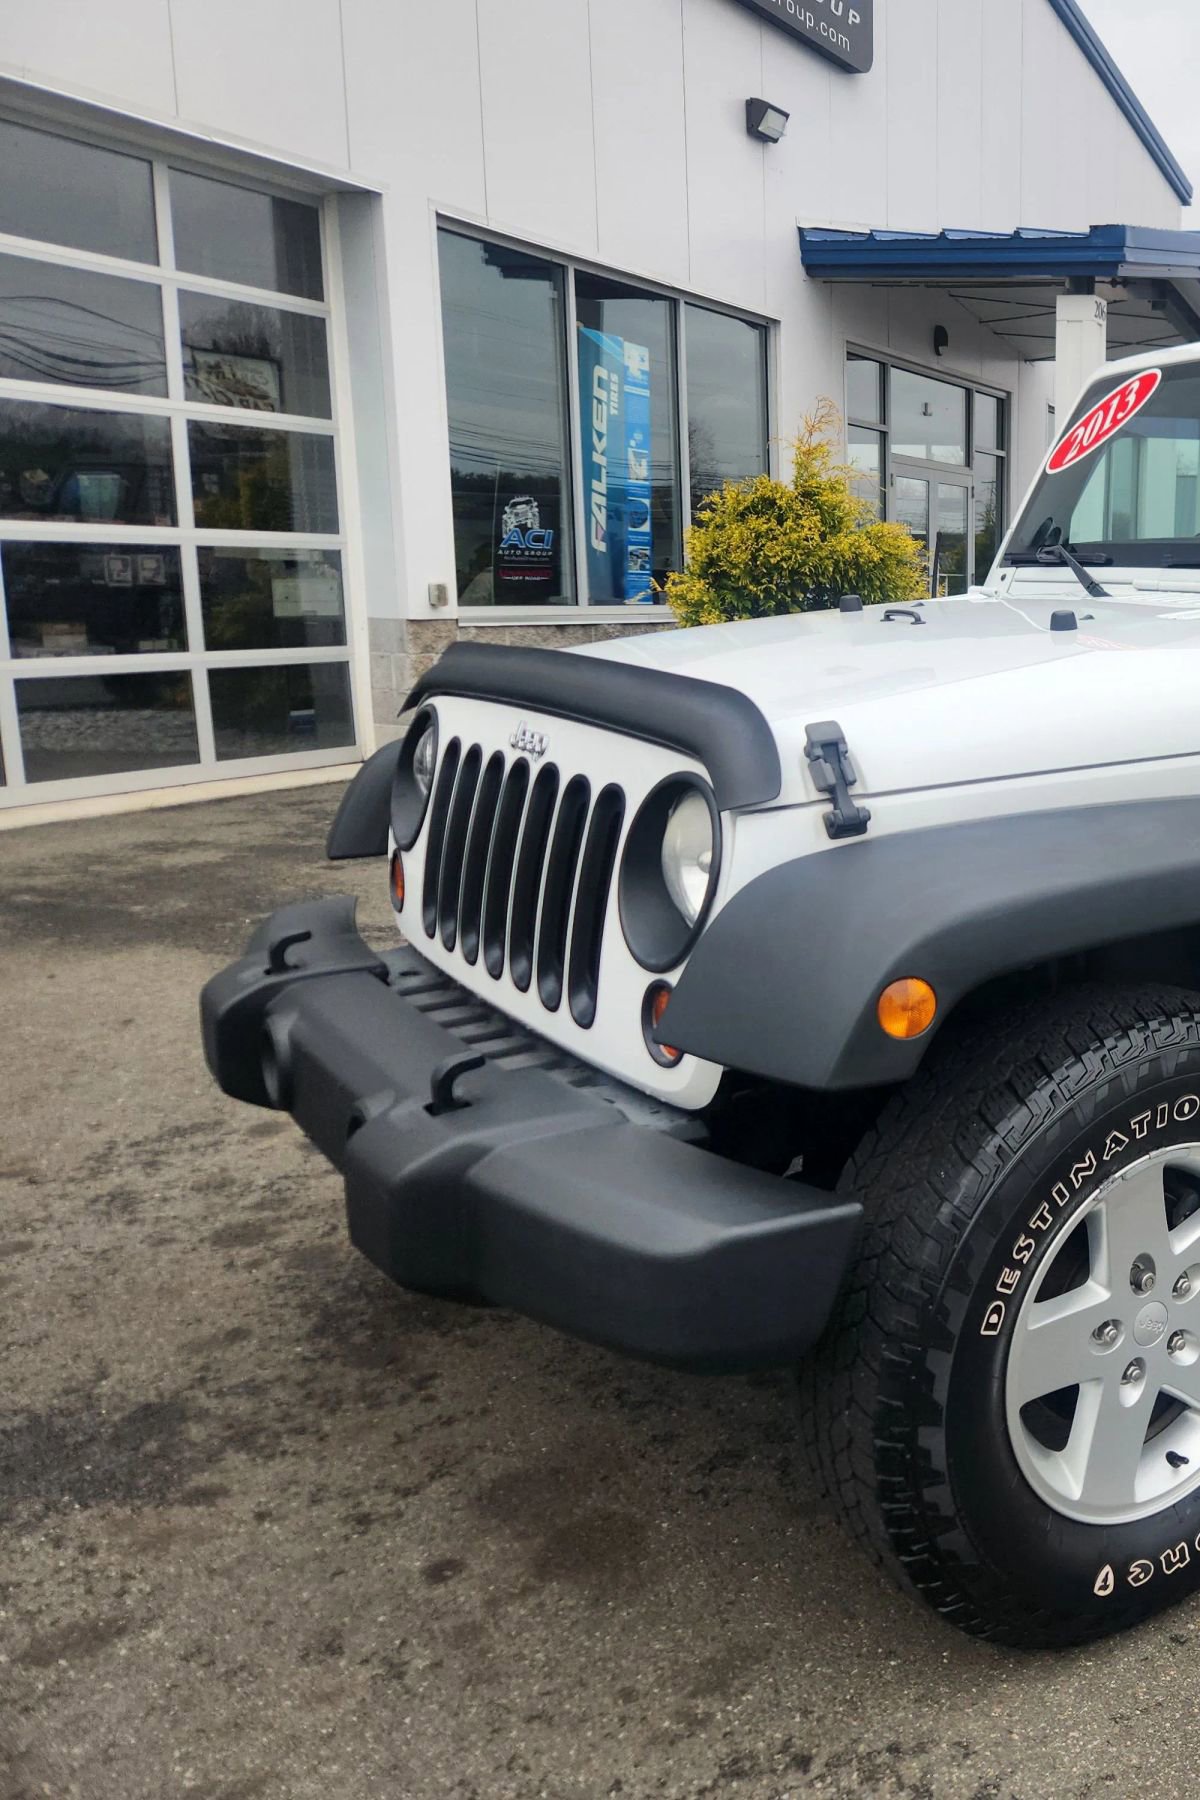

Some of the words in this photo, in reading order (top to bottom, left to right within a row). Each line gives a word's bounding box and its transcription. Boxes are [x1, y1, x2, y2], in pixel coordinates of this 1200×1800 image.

[815, 0, 860, 24] UP
[609, 372, 619, 416] TIRES
[1062, 379, 1141, 465] 2013
[590, 364, 608, 553] FALKEN
[500, 528, 554, 549] ACI
